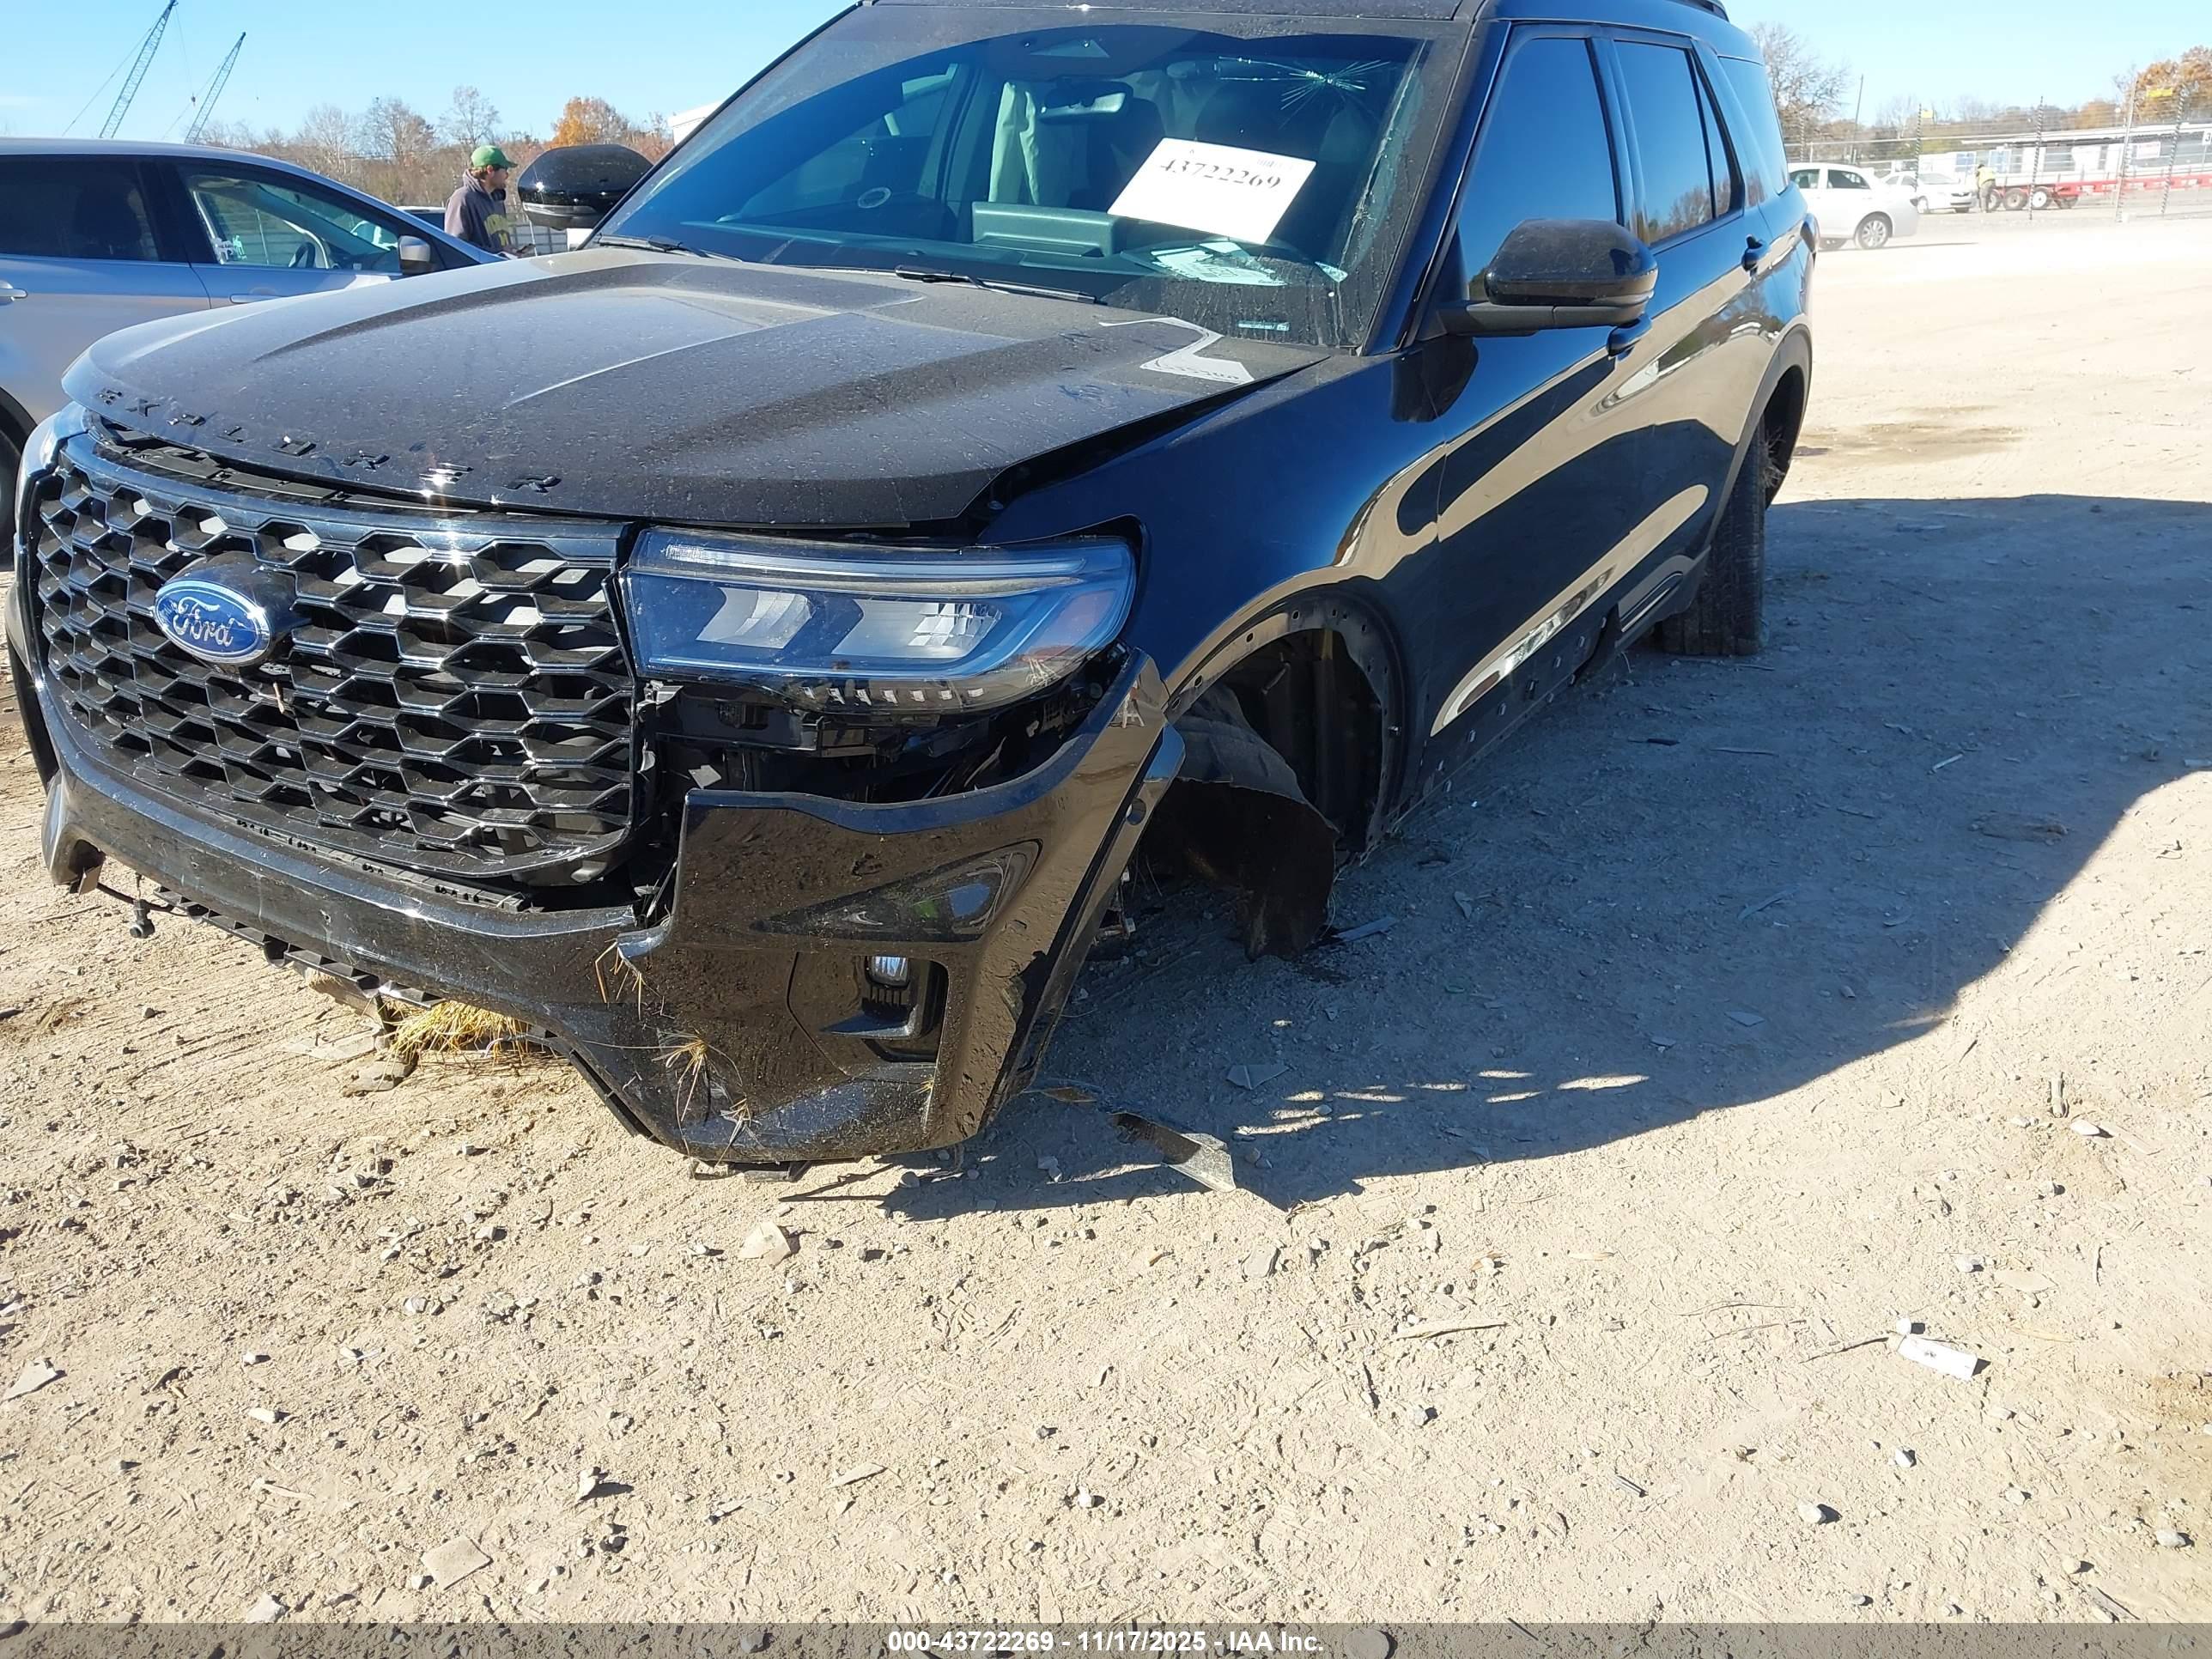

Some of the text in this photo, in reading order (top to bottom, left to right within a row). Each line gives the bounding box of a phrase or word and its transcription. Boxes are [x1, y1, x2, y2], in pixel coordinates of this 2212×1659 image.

[1160, 159, 1281, 188] 43722269
[95, 389, 562, 495] EXPLORER
[173, 596, 248, 647] Ford
